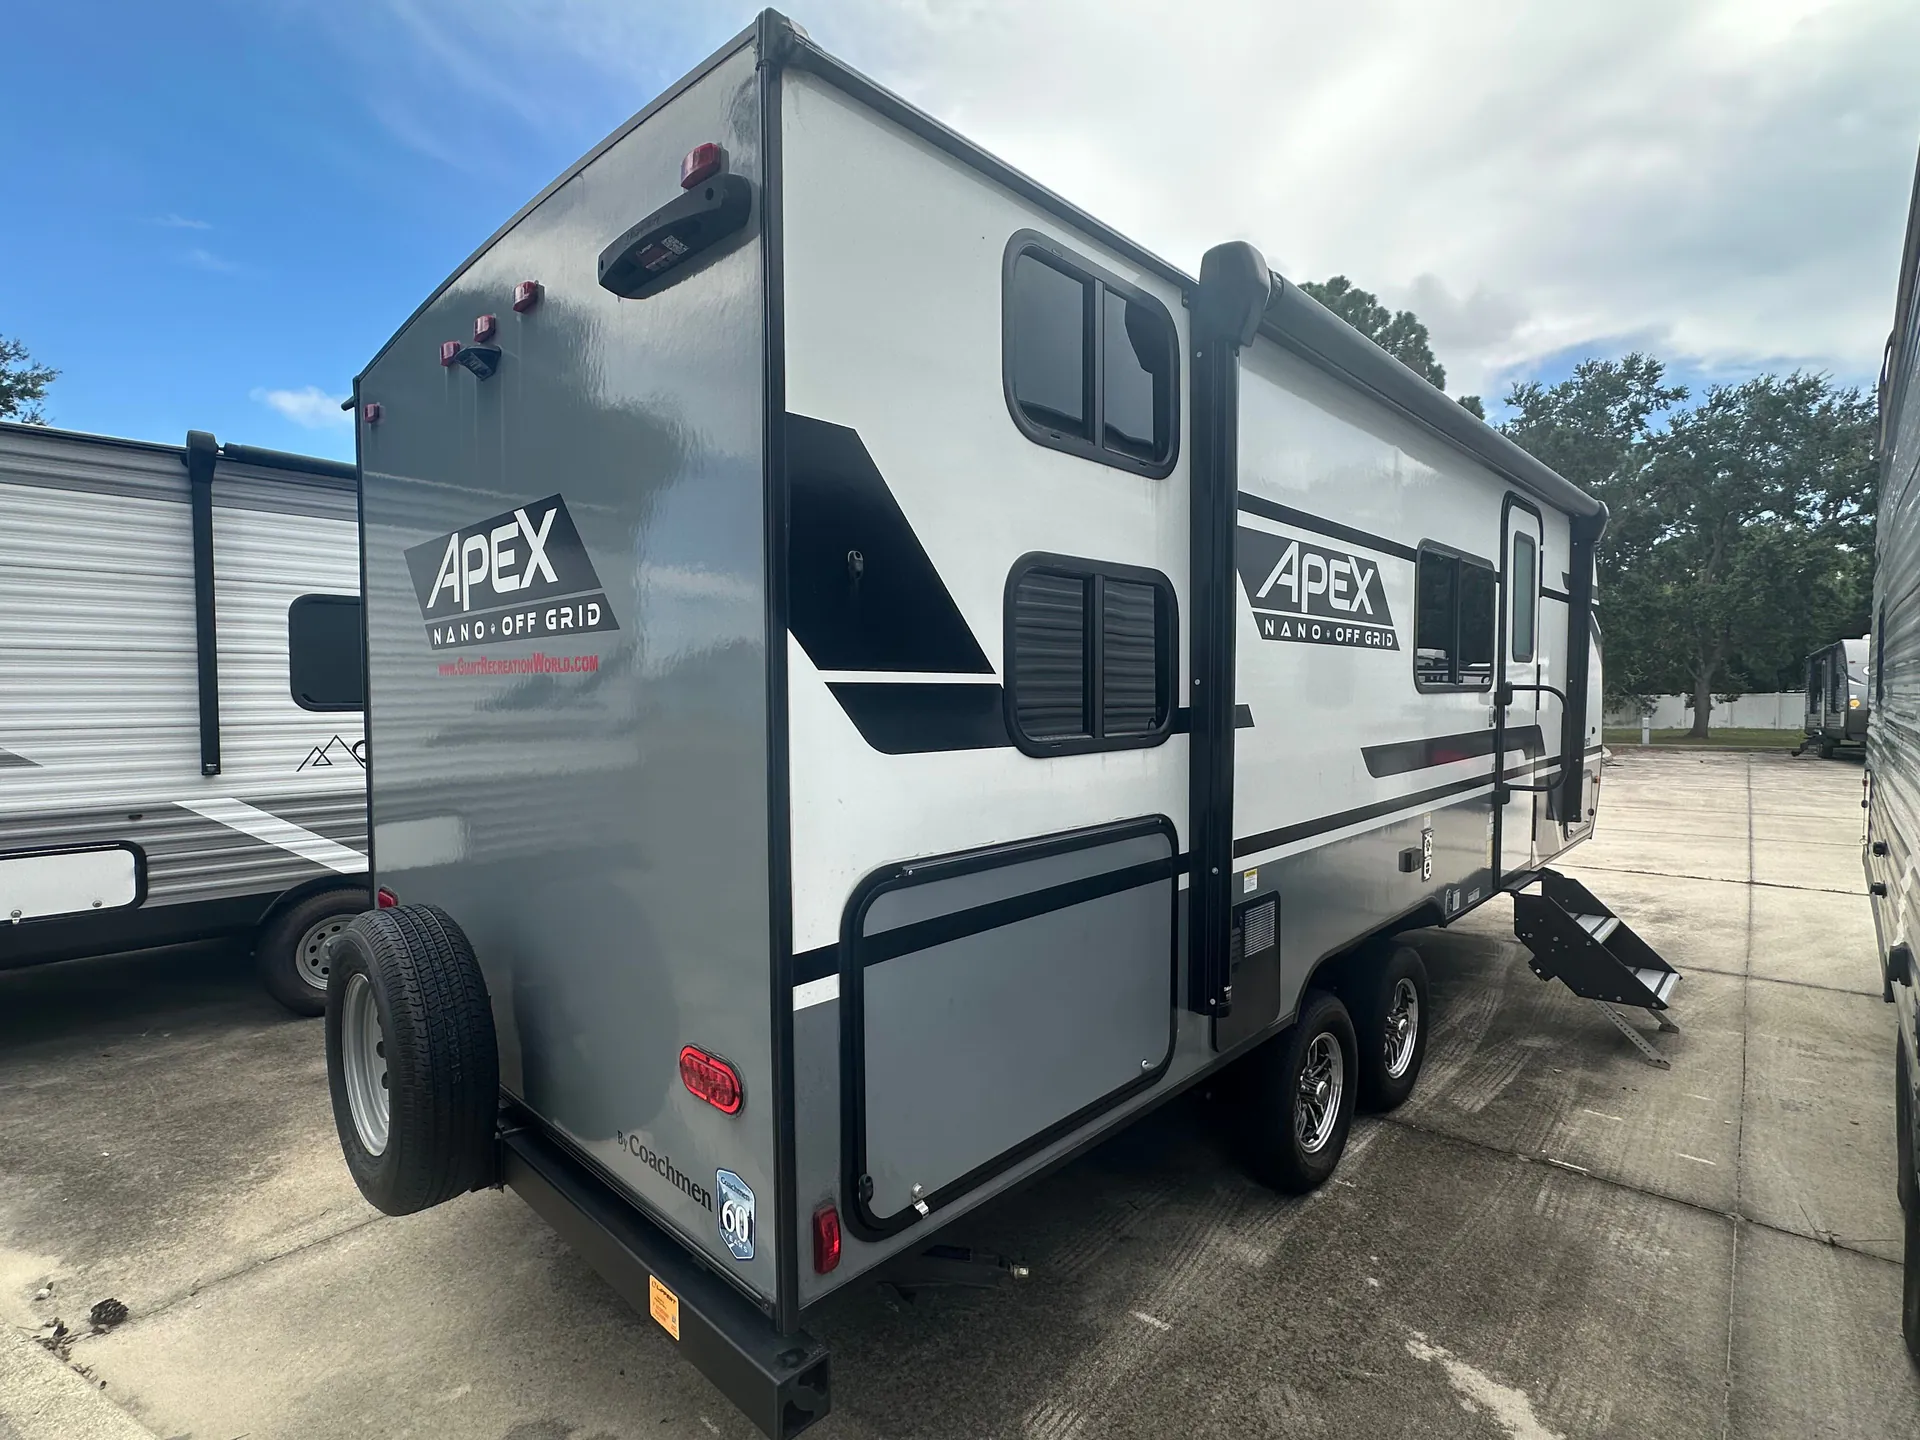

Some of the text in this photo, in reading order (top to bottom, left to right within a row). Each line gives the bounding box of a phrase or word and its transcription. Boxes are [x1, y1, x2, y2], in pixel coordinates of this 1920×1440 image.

[426, 507, 559, 612] APEX
[1256, 541, 1375, 615] APEX
[433, 602, 601, 645] NANO OFF GRID
[1264, 619, 1393, 647] NANO OFF GRID
[617, 1130, 713, 1212] By Coachmen
[722, 1200, 749, 1242] 60
